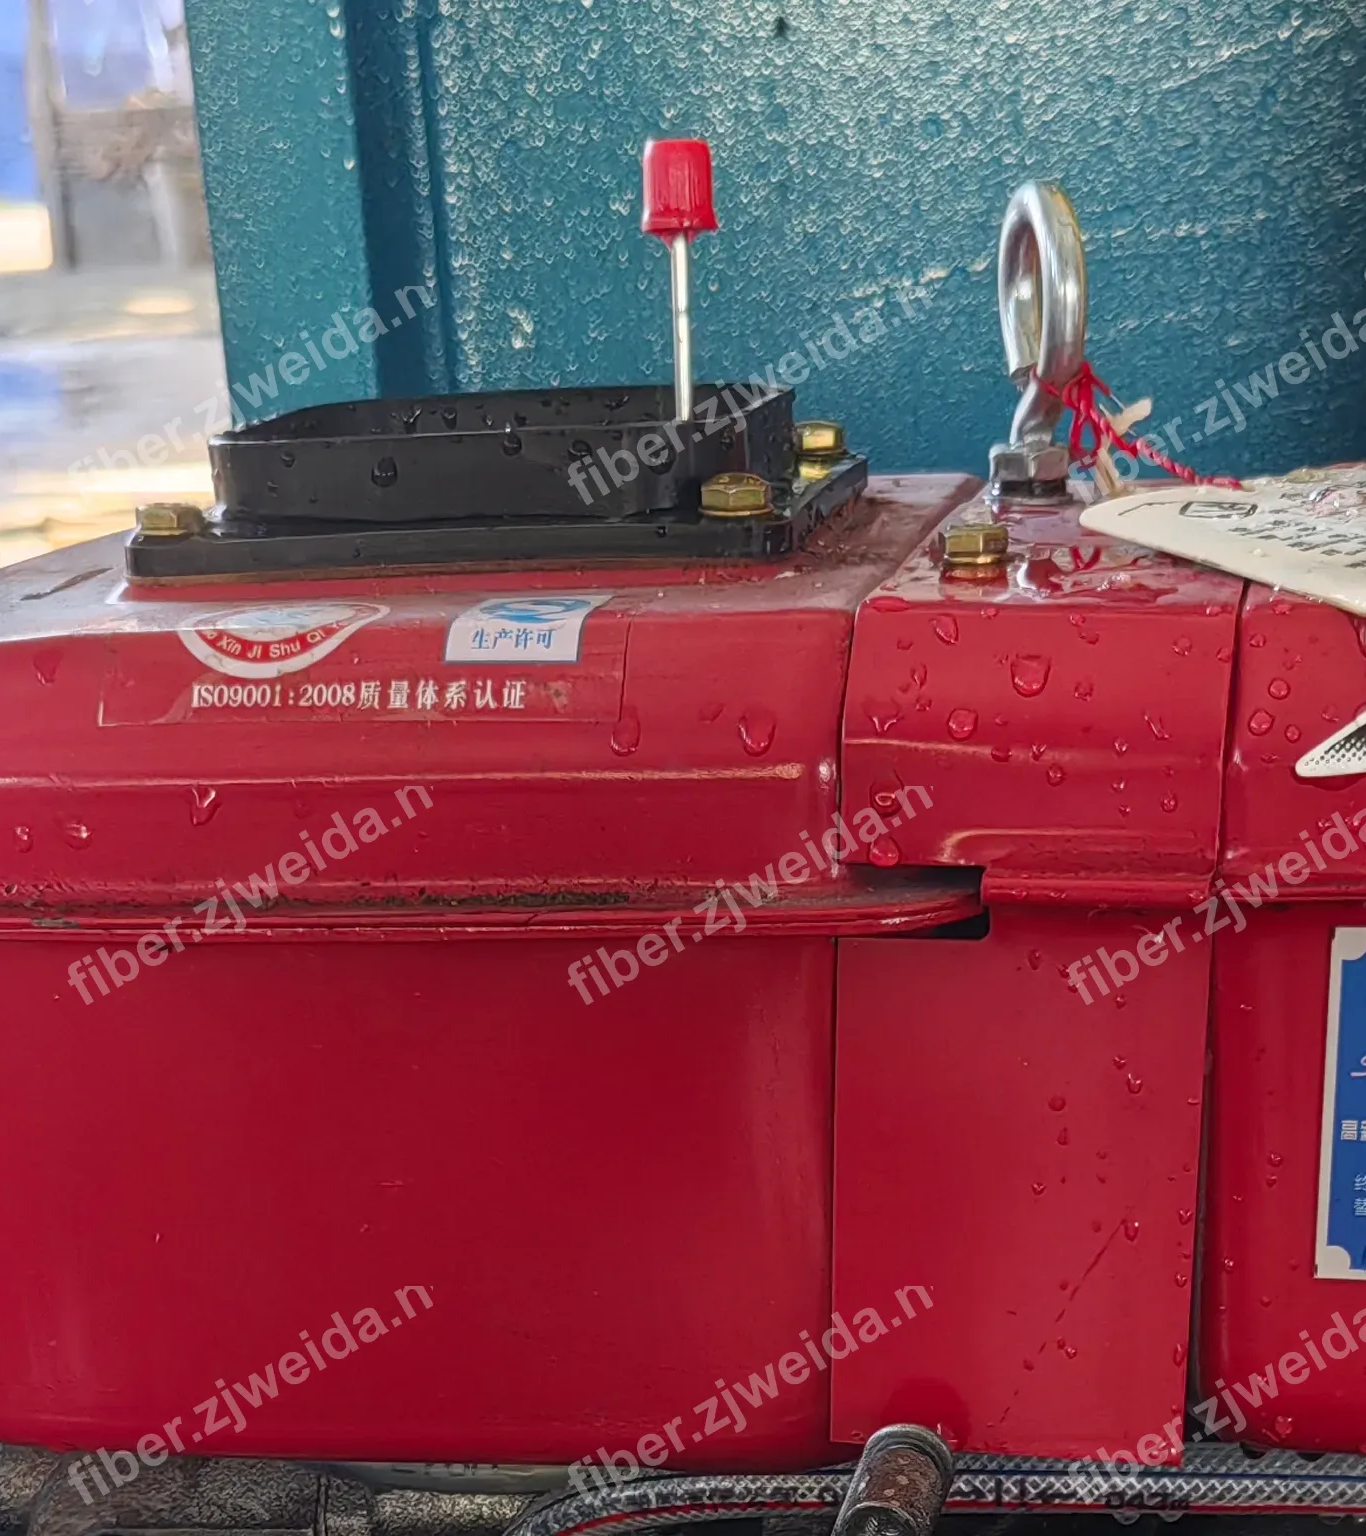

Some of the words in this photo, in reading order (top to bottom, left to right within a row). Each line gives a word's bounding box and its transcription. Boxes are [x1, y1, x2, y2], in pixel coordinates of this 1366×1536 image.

[269, 640, 301, 657] Shu
[470, 628, 557, 650] 生产许可
